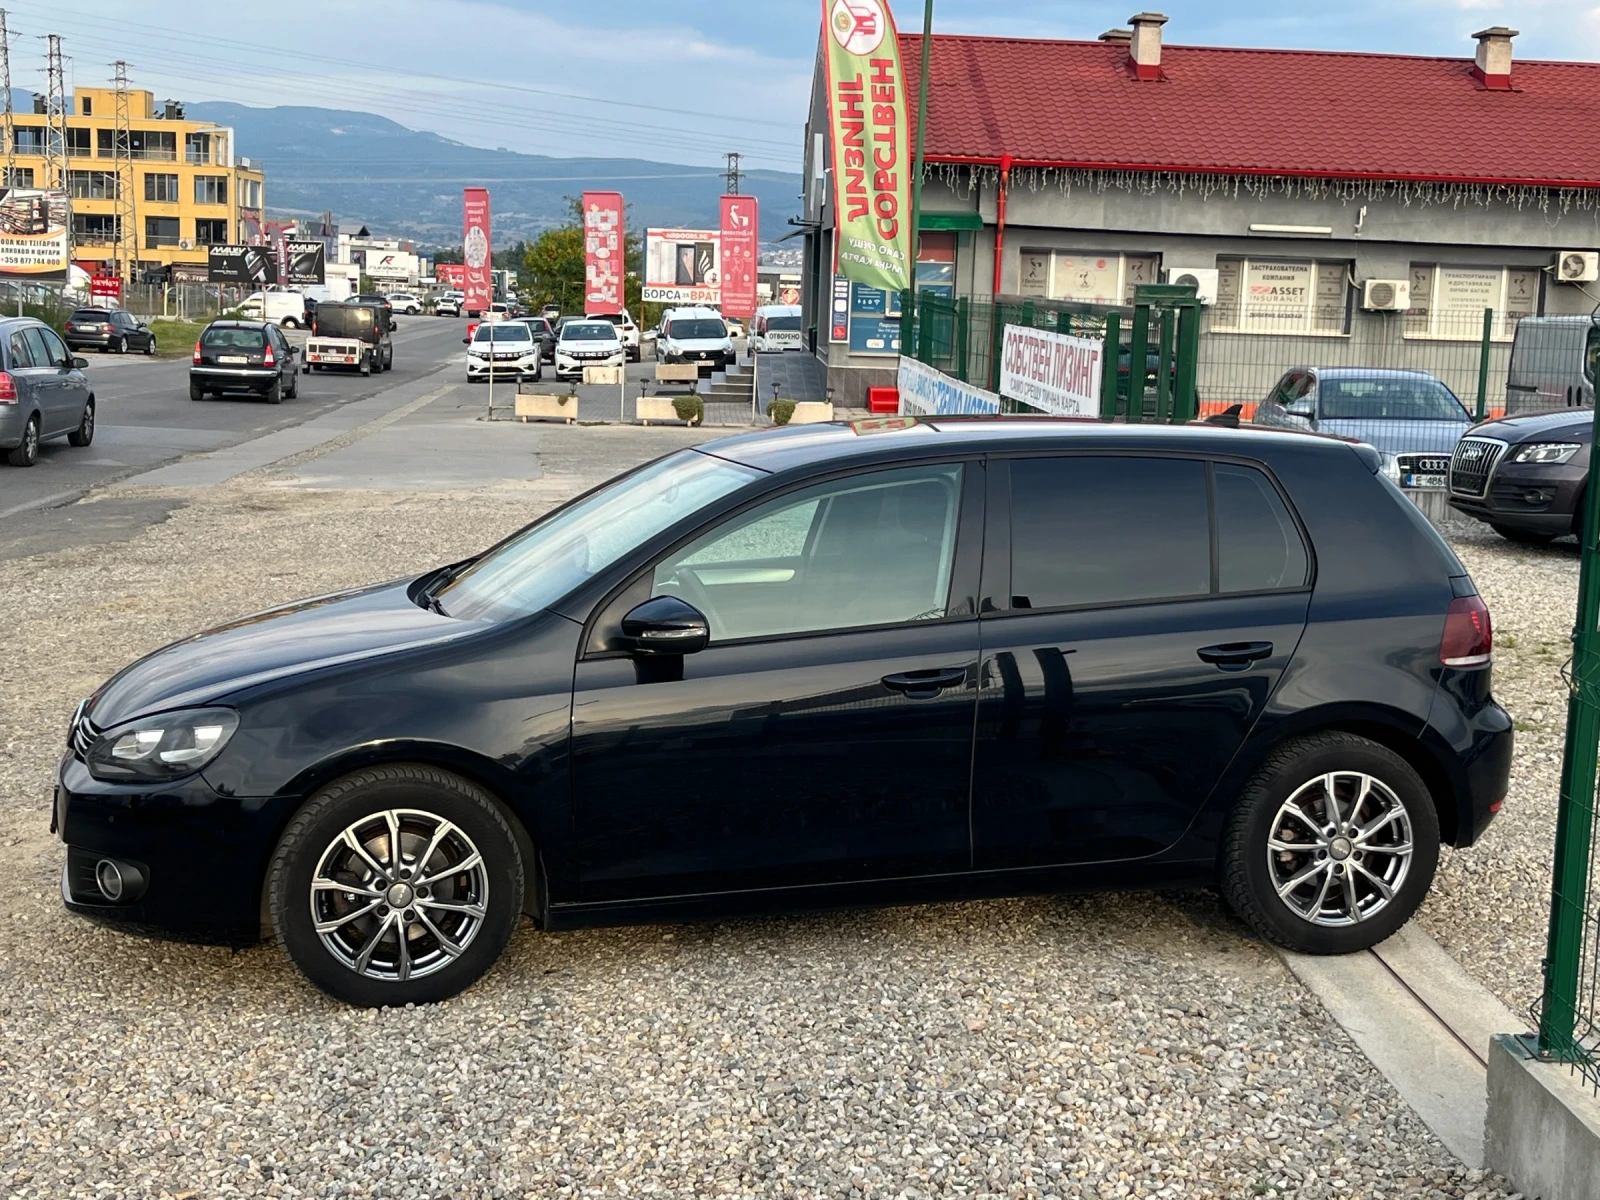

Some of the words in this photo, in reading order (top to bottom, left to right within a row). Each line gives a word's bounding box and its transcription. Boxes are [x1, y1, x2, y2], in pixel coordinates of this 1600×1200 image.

[1251, 264, 1308, 272] ЗАСТРАХОВАТЕЛНА
[1271, 286, 1305, 295] ASSET
[643, 289, 681, 299] БОРСА
[690, 291, 720, 301] ВРАТ
[1250, 295, 1305, 303] INSURANCE
[769, 332, 800, 340] ОТВОРЕНО
[1005, 332, 1050, 385] СОБСТВЕН
[1051, 343, 1098, 398] ЛИЗИНГ
